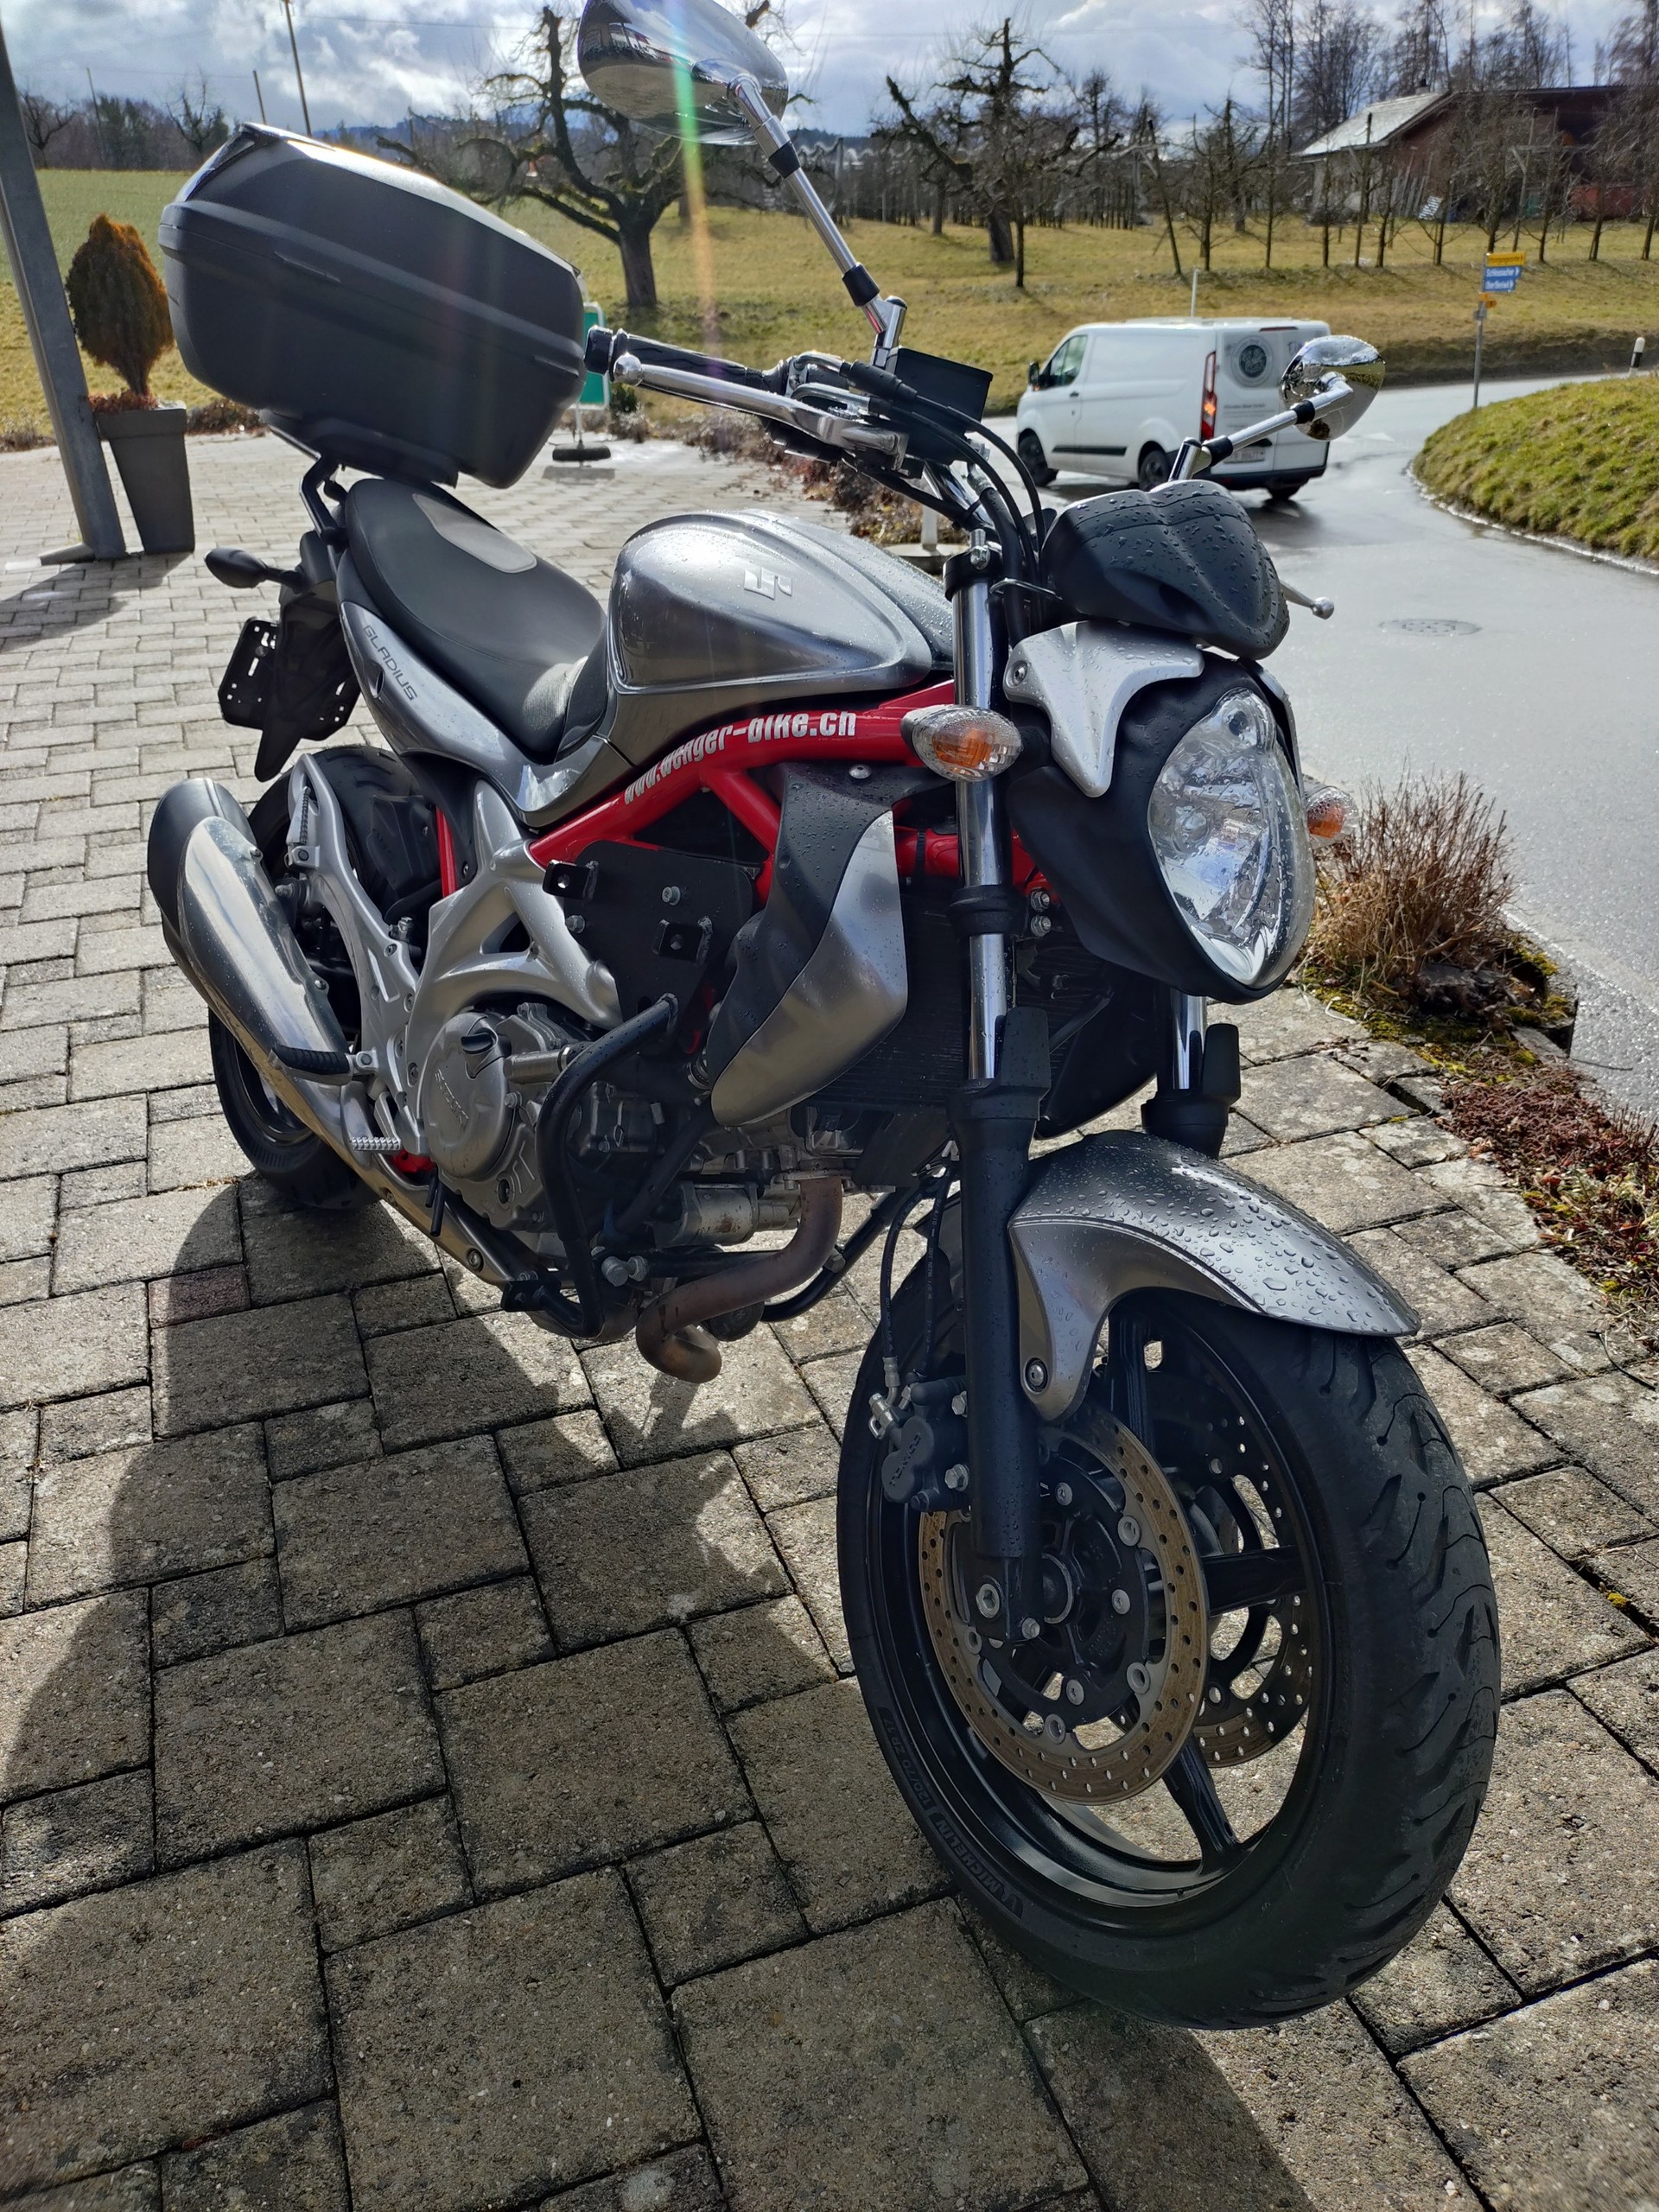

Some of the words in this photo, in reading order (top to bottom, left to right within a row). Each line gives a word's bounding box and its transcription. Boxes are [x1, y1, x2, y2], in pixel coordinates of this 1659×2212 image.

[363, 625, 418, 701] GLADIUS
[624, 710, 857, 805] www.wenger-bike.ch
[901, 1758, 933, 1808] 120/70
[935, 1818, 1001, 1895] MICHELIN
